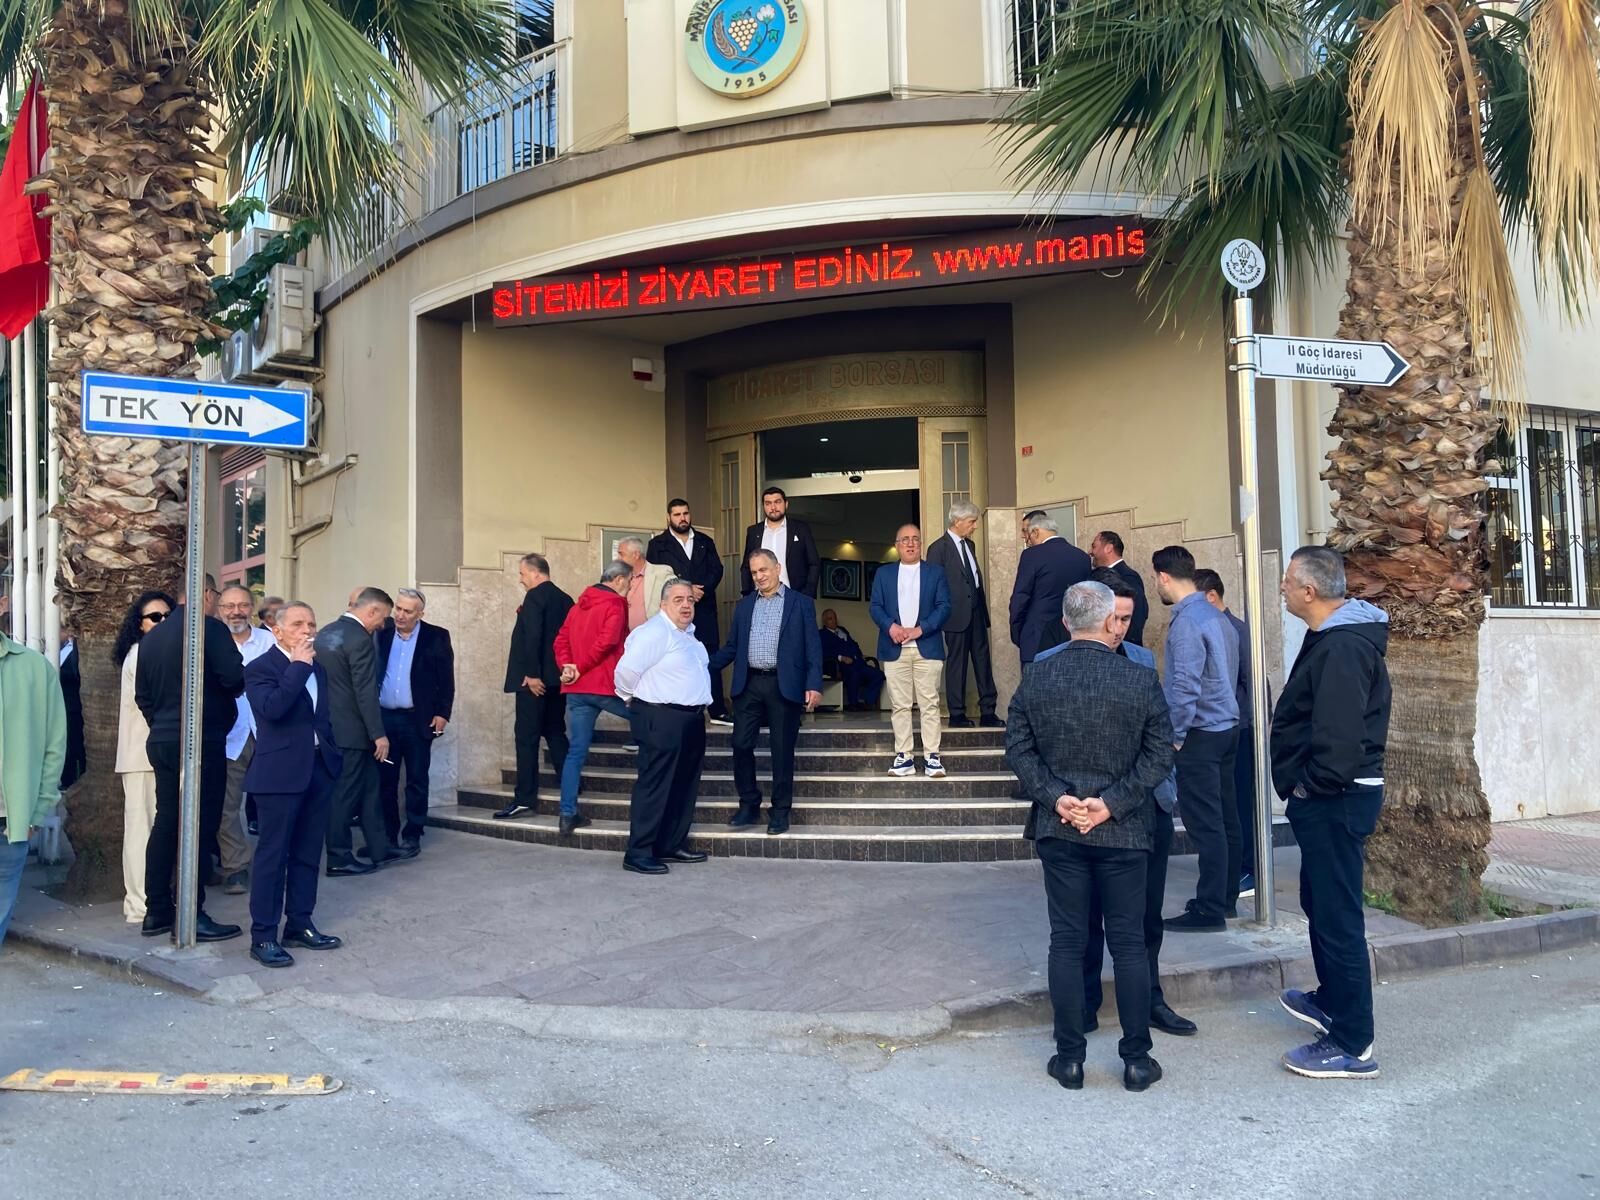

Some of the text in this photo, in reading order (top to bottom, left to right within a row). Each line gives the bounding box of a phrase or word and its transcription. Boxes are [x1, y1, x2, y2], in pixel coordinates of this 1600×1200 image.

[724, 72, 767, 88] 1925
[492, 225, 1144, 318] SİTEMİZİ ZİYARET EDİNİZ. www.manis
[1287, 342, 1362, 361] İl Göç İdaresi
[830, 358, 945, 389] BORSASI
[1296, 363, 1356, 379] Müdürlüğü
[99, 394, 243, 427] TEK YÖN
